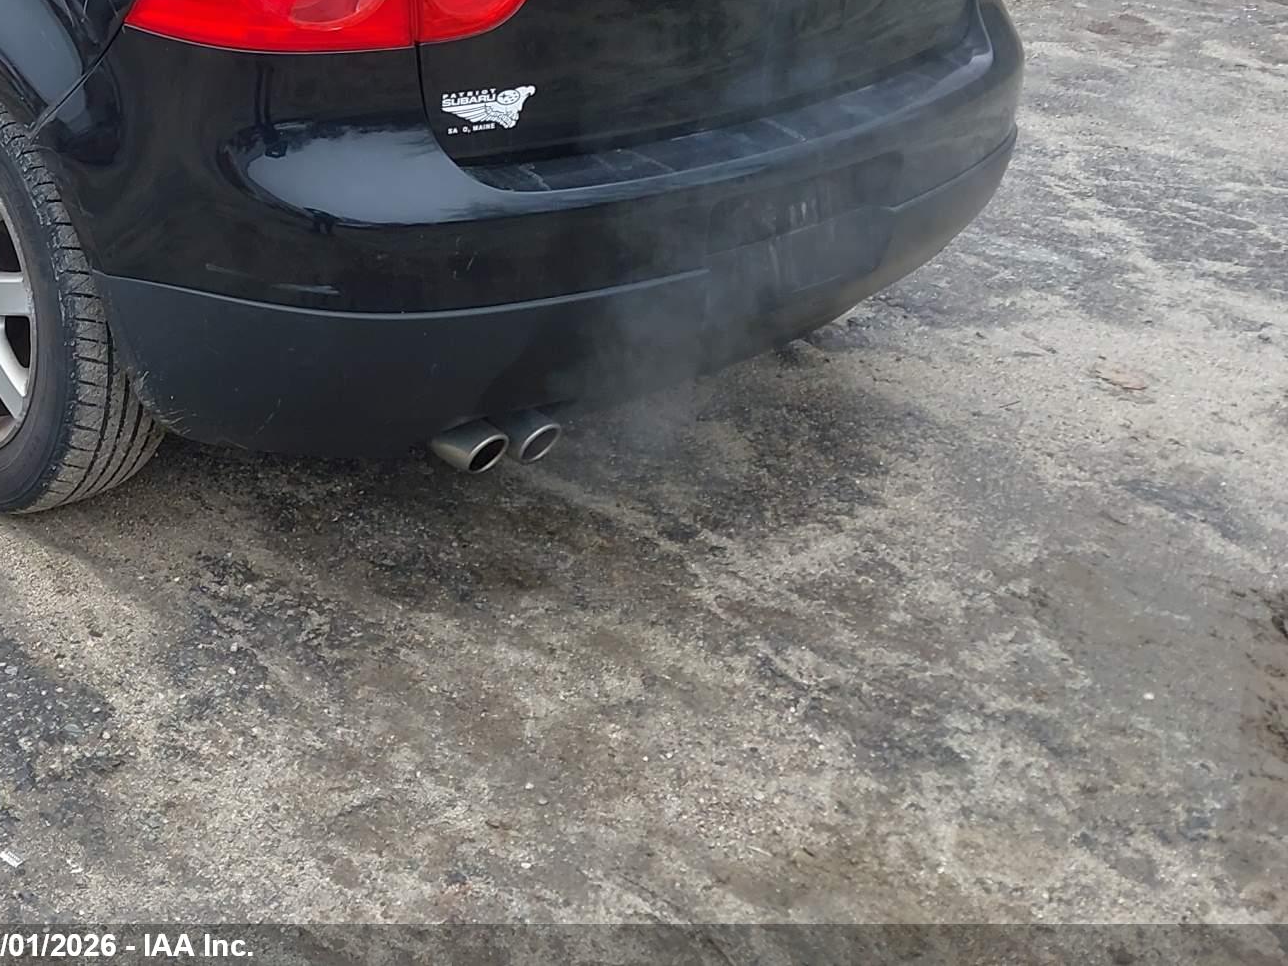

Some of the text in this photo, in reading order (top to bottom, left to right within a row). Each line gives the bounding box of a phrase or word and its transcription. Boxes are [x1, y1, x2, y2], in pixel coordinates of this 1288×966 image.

[442, 88, 496, 99] PATRIOT
[442, 94, 496, 107] SUBARU
[472, 122, 496, 132] MAINE
